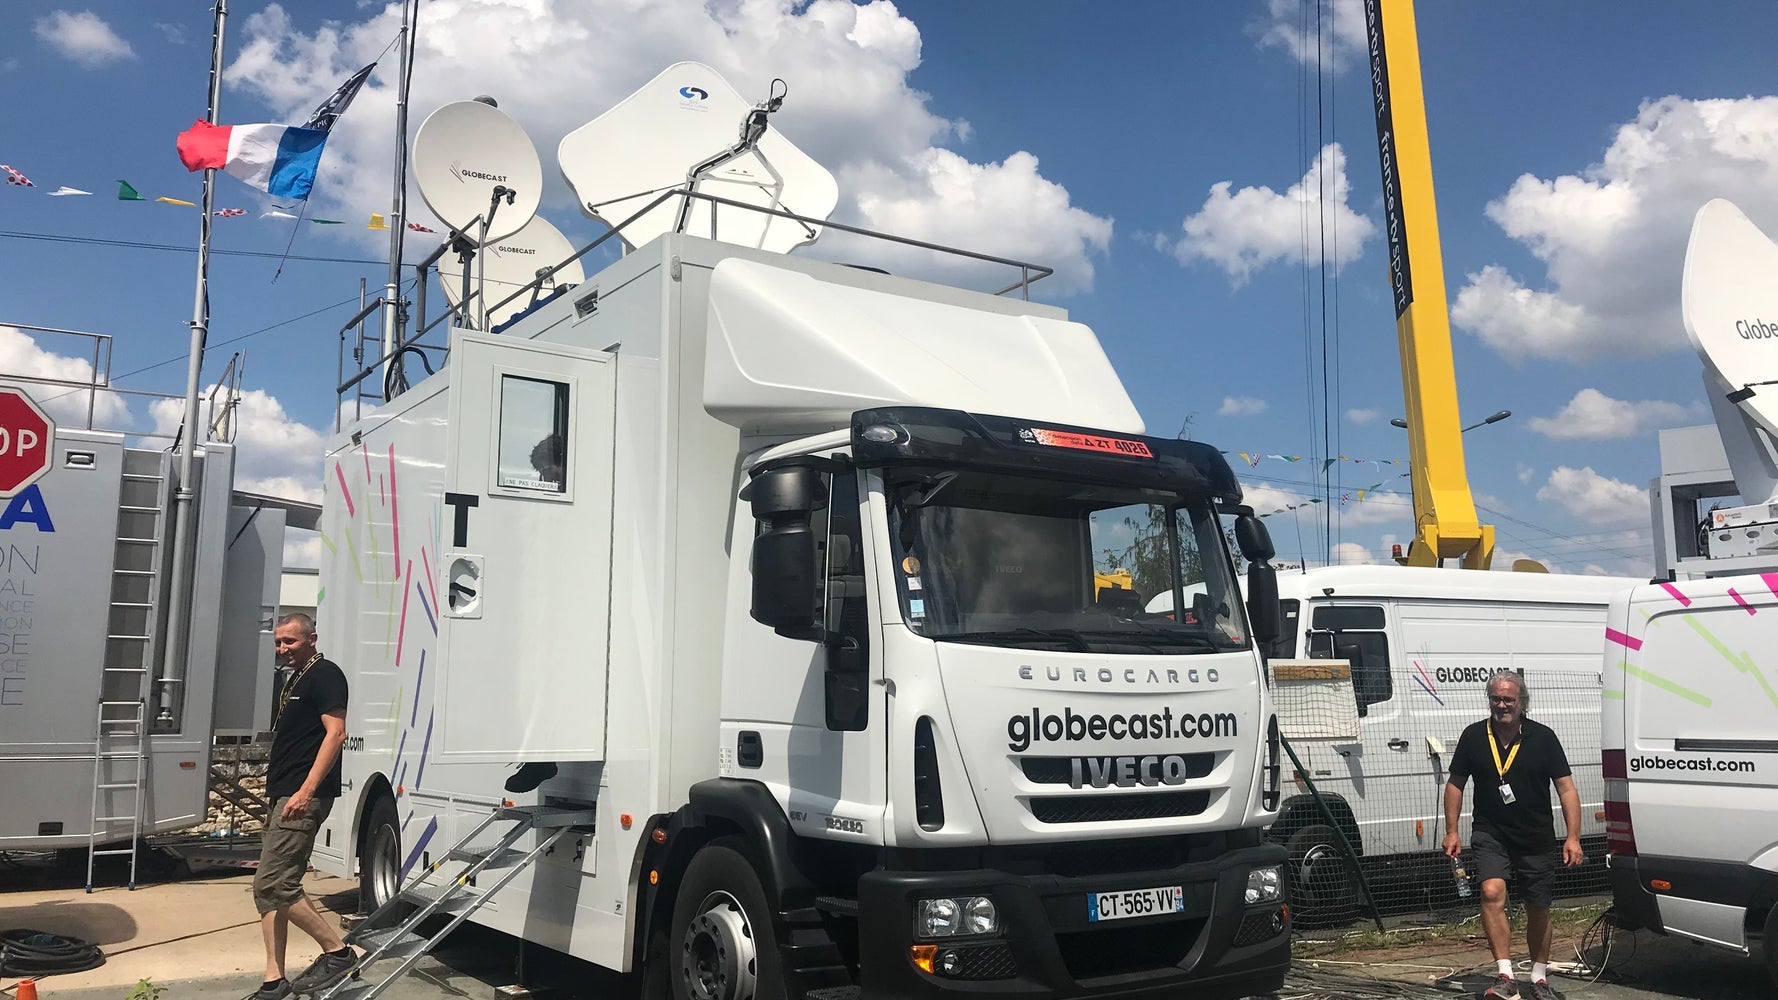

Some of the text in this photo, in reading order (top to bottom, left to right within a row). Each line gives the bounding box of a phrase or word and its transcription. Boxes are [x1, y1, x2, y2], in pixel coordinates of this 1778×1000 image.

[1372, 57, 1386, 119] sport
[461, 169, 507, 182] GLOBECAST
[498, 245, 536, 255] GLOBECAST
[1391, 244, 1407, 310] sport
[1095, 439, 1110, 448] ZT
[1114, 440, 1148, 454] 4026
[445, 492, 479, 547] T
[1018, 664, 1220, 683] EUROCARGO
[1007, 706, 1238, 752] globecast.com
[1069, 755, 1188, 789] IVECO
[1630, 756, 1755, 773] globecast.com
